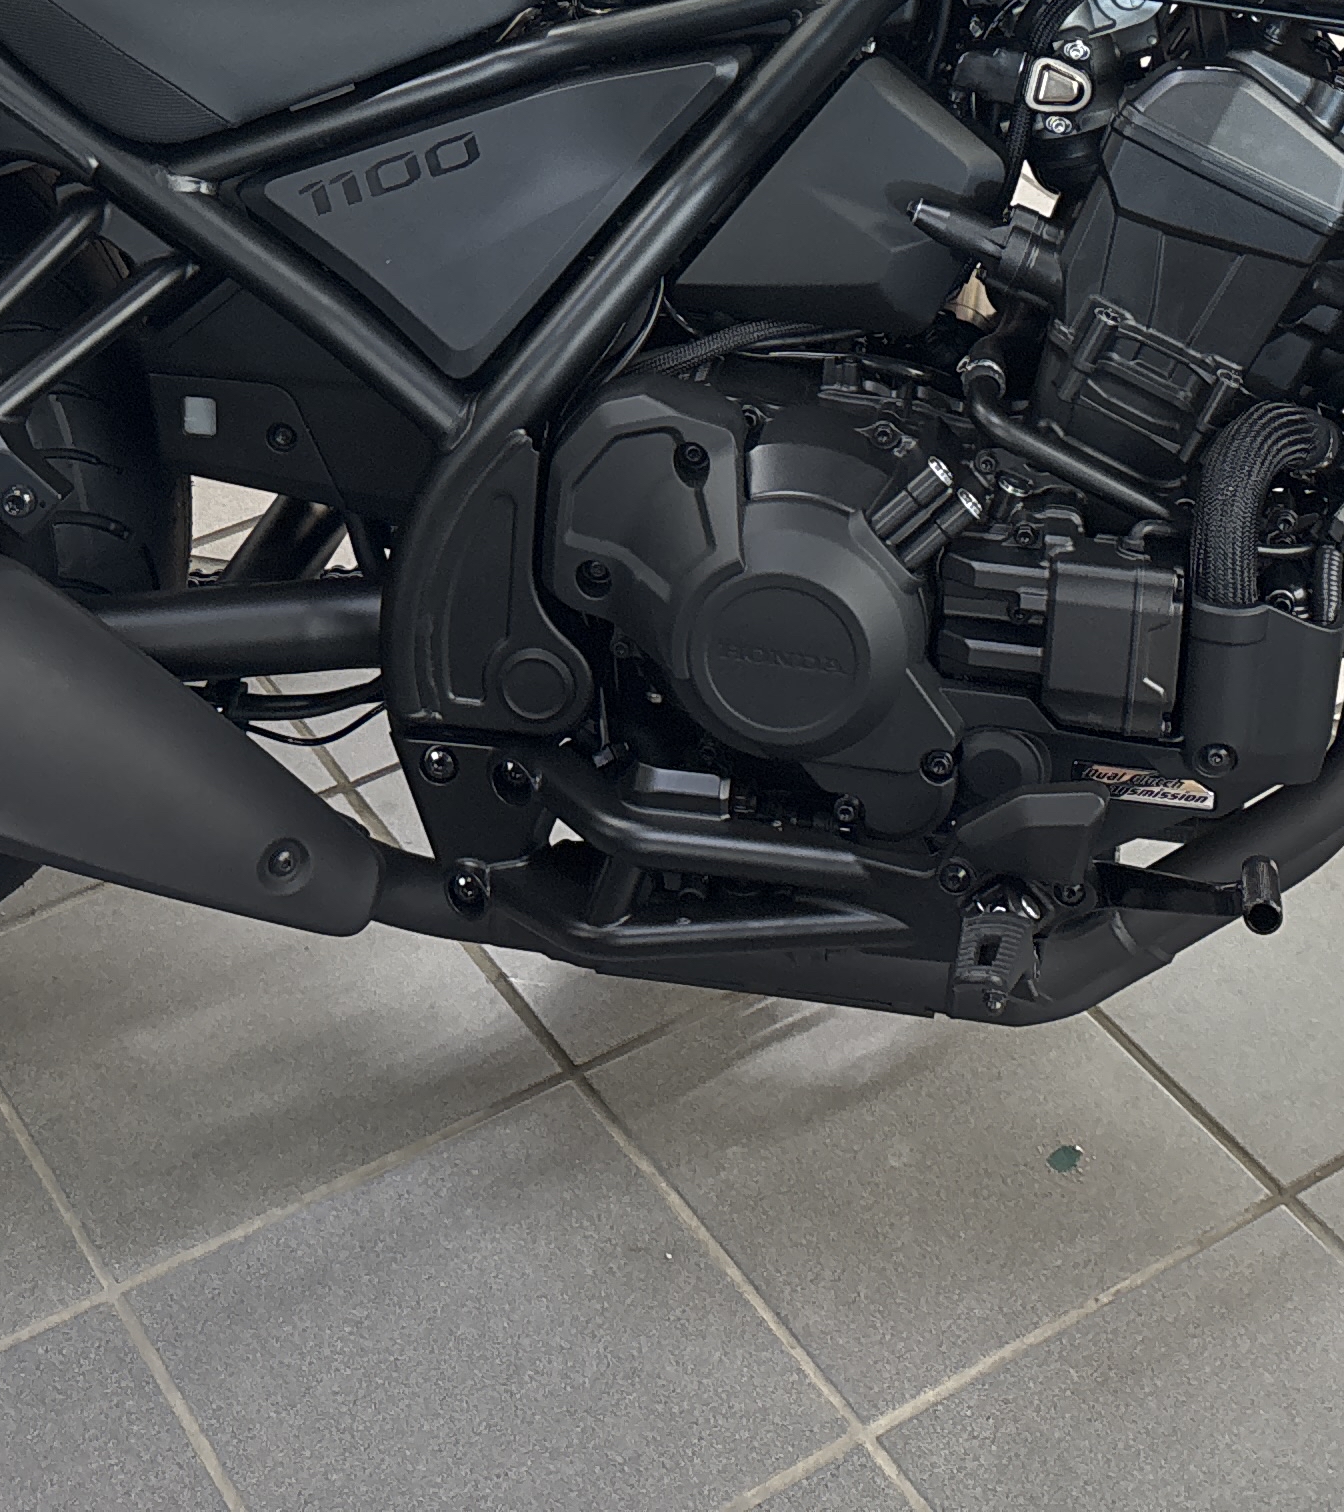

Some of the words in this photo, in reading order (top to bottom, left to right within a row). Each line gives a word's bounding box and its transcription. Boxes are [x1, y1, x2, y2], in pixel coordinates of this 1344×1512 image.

[297, 130, 481, 217] 1100
[717, 642, 850, 677] HONDA
[1083, 767, 1126, 784] Dual
[1110, 783, 1210, 805] nsmission
